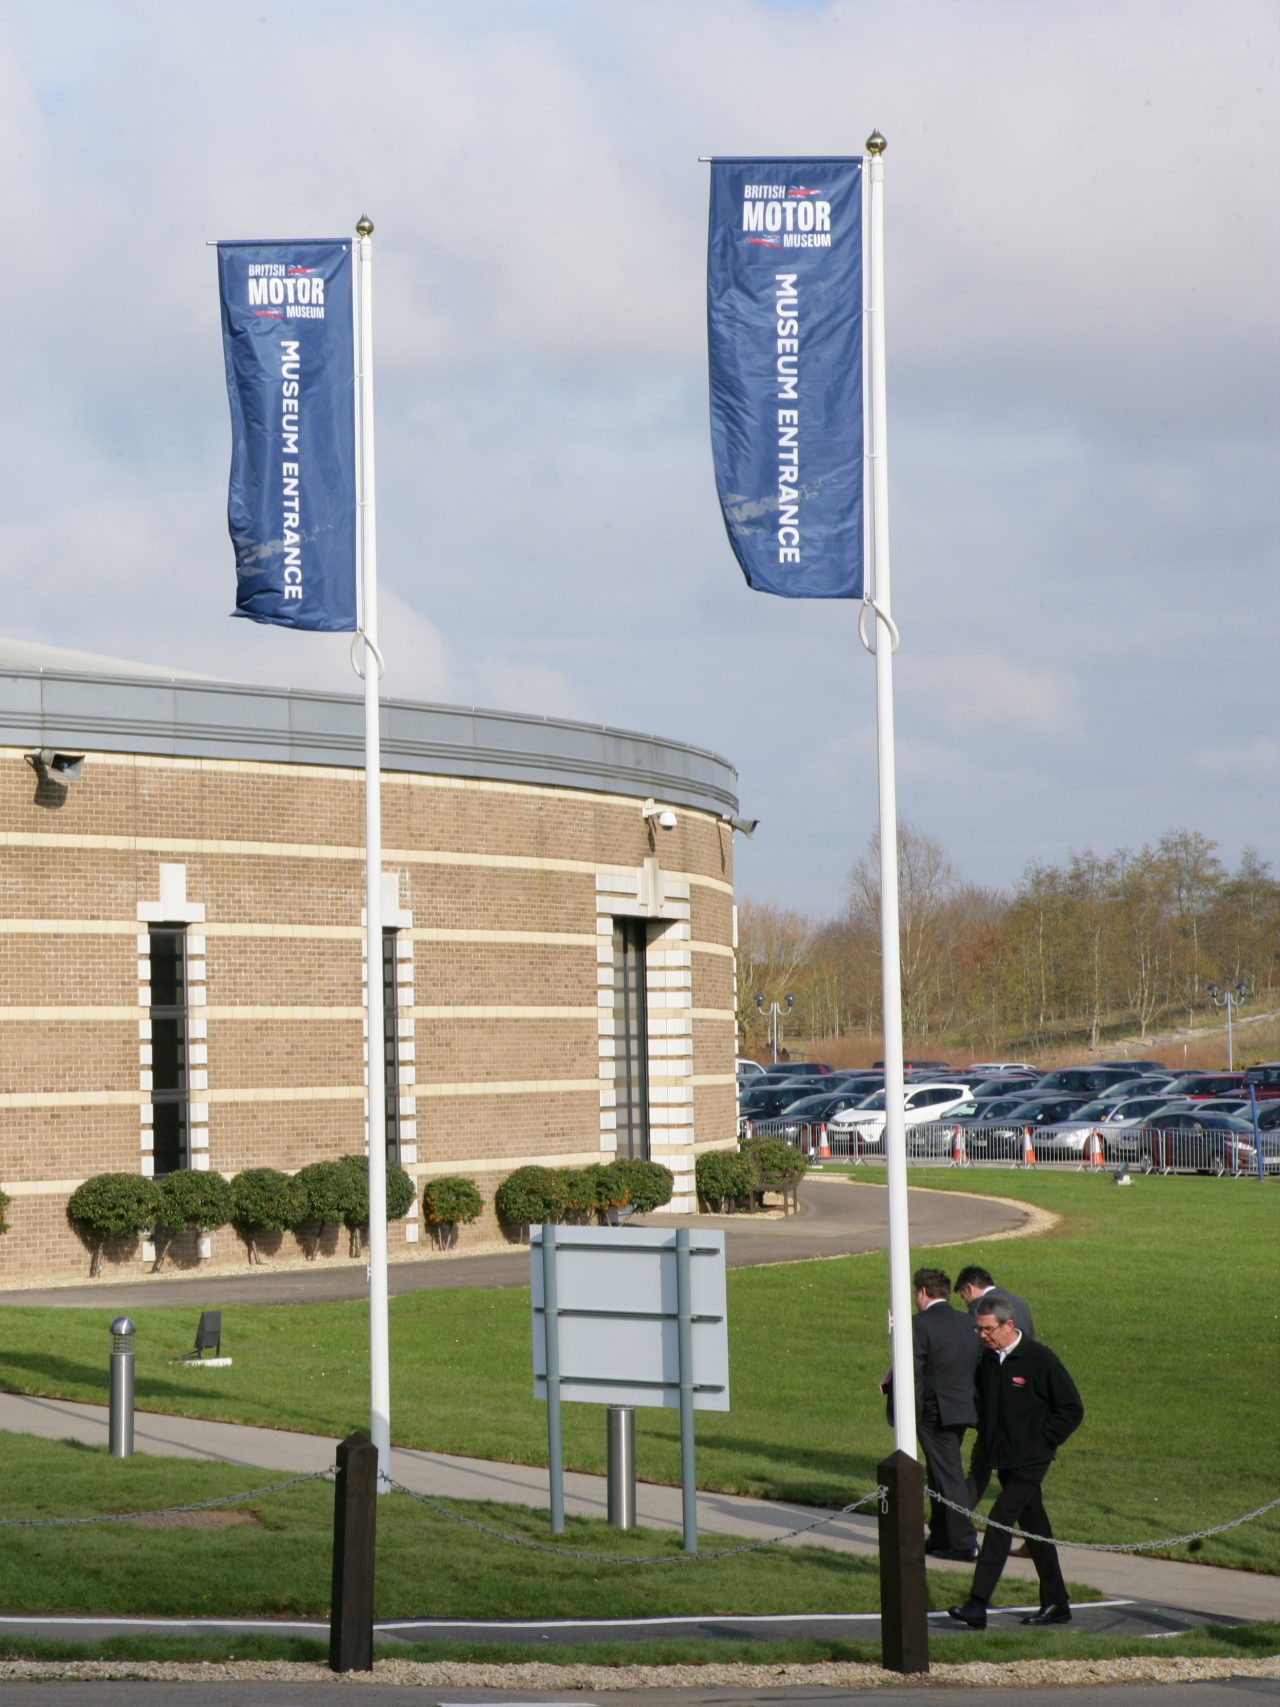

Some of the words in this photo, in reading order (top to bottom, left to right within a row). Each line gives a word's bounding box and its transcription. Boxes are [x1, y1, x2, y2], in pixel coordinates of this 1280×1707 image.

[744, 184, 786, 199] BRITISH
[742, 201, 831, 232] MOTOR
[783, 233, 832, 248] MUSEUM
[248, 264, 286, 276] BRITISH
[248, 278, 325, 305] MOTOR
[286, 305, 325, 319] MUSEUM
[775, 273, 798, 400] MUSEUM
[280, 340, 300, 454] MUSEUM
[778, 409, 800, 564] ENTRANCE
[282, 462, 303, 600] ENTRANCE
